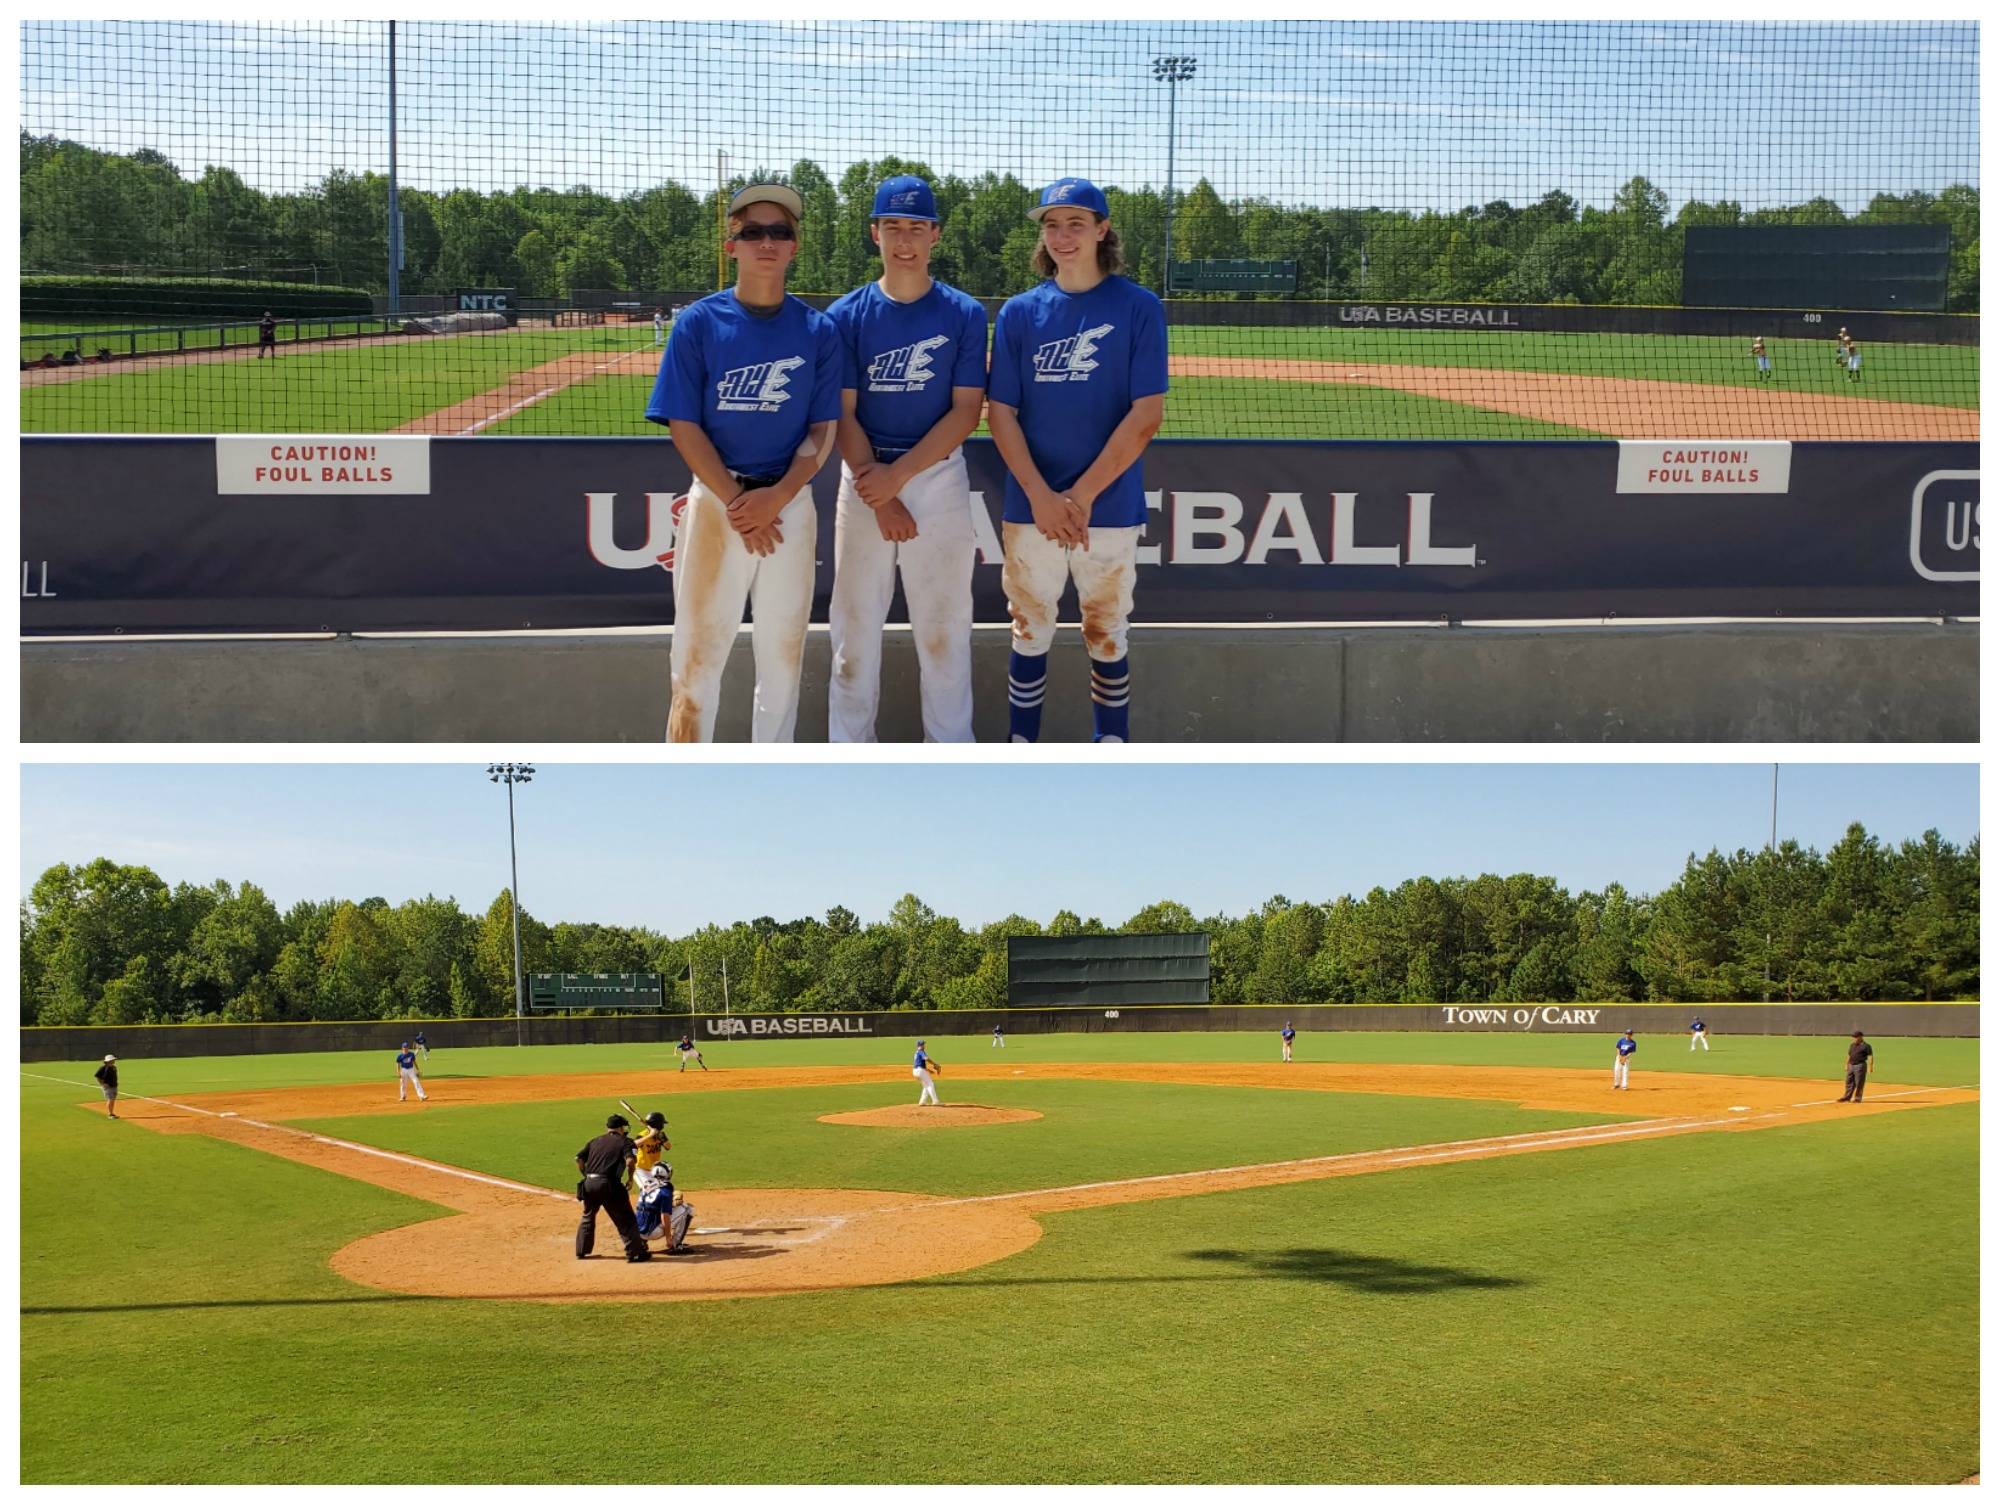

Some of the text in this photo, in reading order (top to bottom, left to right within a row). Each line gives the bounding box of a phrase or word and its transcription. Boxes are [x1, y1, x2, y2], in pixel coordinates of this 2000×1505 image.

[460, 294, 507, 310] NTC
[1385, 307, 1519, 326] BASEBALL
[1802, 313, 1822, 323] 400
[271, 446, 376, 461] CAUTION!
[1663, 450, 1749, 464] CAUTION!
[255, 467, 393, 482] FOUL BALLS
[1648, 469, 1760, 483] FOUL BALLS
[1946, 502, 1980, 550] U
[1104, 1010, 1120, 1018] 400
[751, 1017, 872, 1034] BASEBALL
